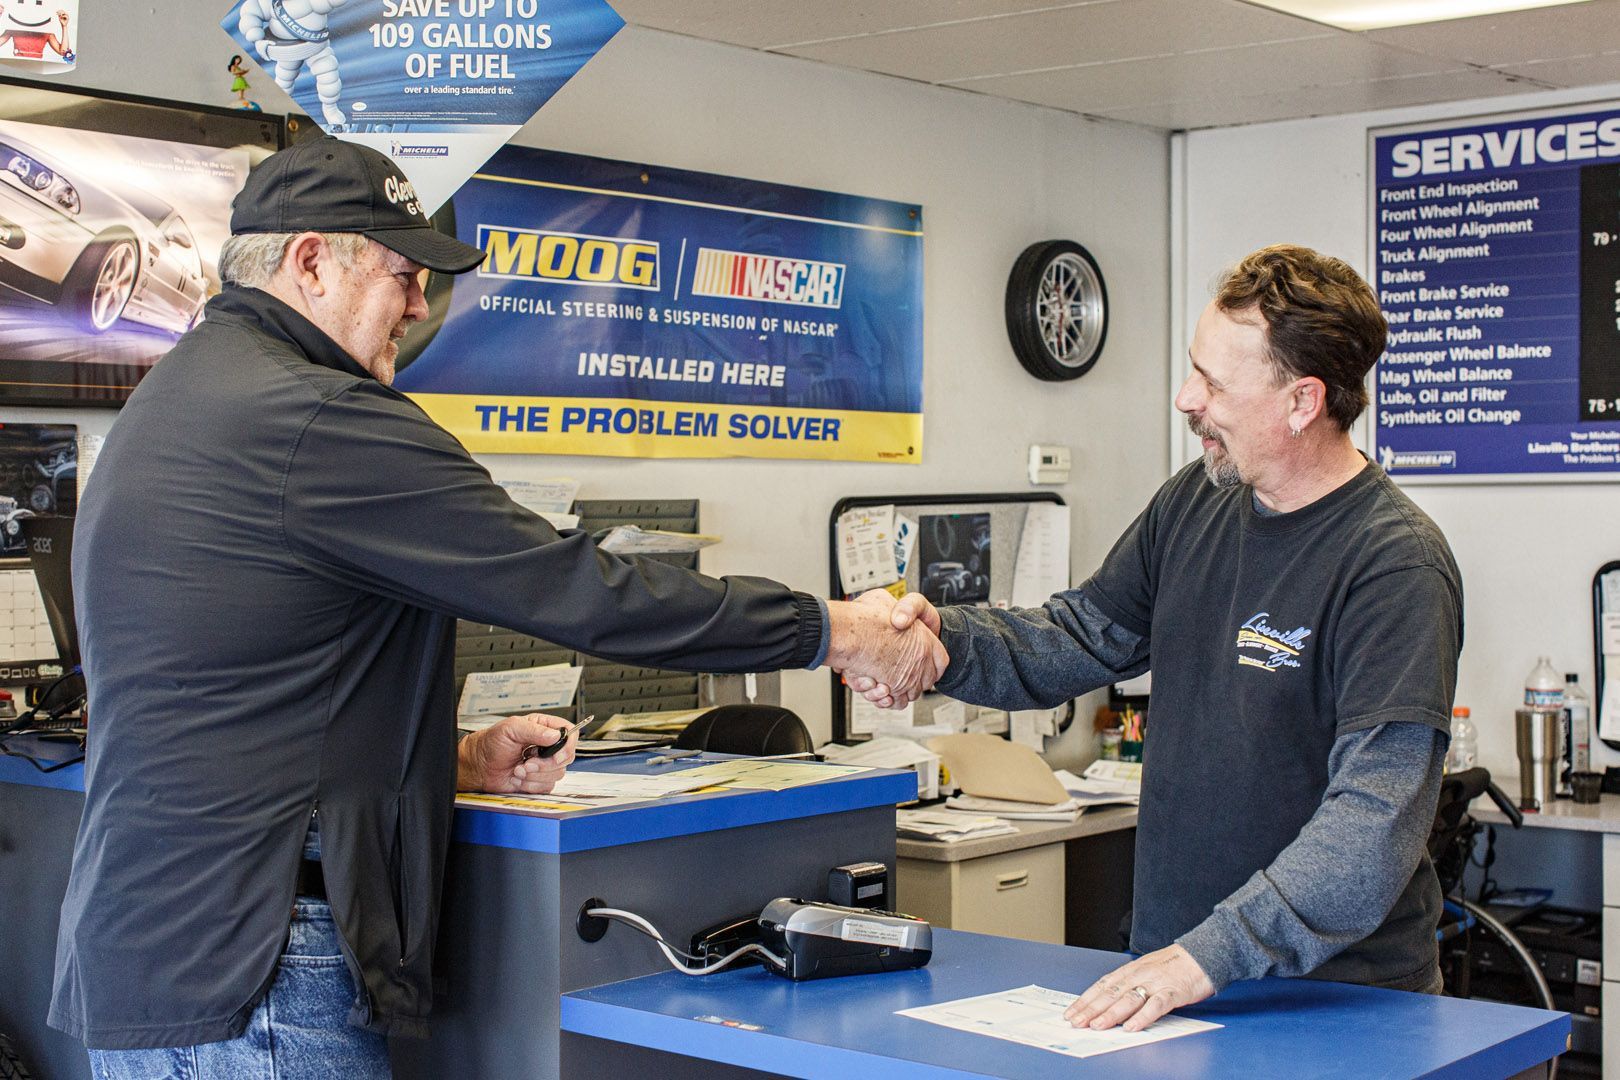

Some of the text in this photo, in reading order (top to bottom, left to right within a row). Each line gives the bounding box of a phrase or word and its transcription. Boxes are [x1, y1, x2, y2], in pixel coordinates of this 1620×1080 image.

[382, 0, 538, 18] SAVE UP TO
[280, 13, 330, 40] MICHELIN
[369, 23, 553, 50] 109 GALLONS
[405, 53, 516, 80] OF FUEL
[404, 86, 422, 94] over
[423, 86, 430, 94] a
[430, 85, 460, 96] leading
[461, 85, 497, 95] standard
[402, 146, 447, 154] MICHELIN
[1391, 118, 1620, 178] SERVICES
[385, 175, 417, 204] Clev
[1381, 178, 1518, 203] Front End Inspection
[1381, 196, 1540, 223] Front Wheel Alignment
[1380, 218, 1533, 244] Four Wheel Alignment
[481, 230, 657, 287] MOOG
[1380, 243, 1490, 264] Truck Alignment
[744, 256, 838, 305] NASCAR
[1381, 269, 1426, 285] Brakes
[1381, 282, 1510, 304] Front Brake Service
[480, 295, 556, 316] OFFICIAL
[562, 301, 644, 321] STEERING
[649, 307, 658, 323] &
[663, 309, 756, 331] SUSPENSION
[761, 317, 779, 332] OF
[1413, 307, 1452, 323] Brake
[1455, 303, 1505, 320] Service
[1446, 325, 1482, 342] Flush
[1381, 343, 1552, 366] Passenger Wheel Balance
[577, 352, 787, 388] INSTALLED HERE
[1380, 366, 1513, 387] Mag Wheel Balance
[1380, 386, 1507, 406] Lube, Oil and Filter
[475, 404, 842, 441] THE PROBLEM SOLVER
[1380, 408, 1522, 427] Synthetic Oil Change
[1394, 454, 1454, 465] MICHELIN
